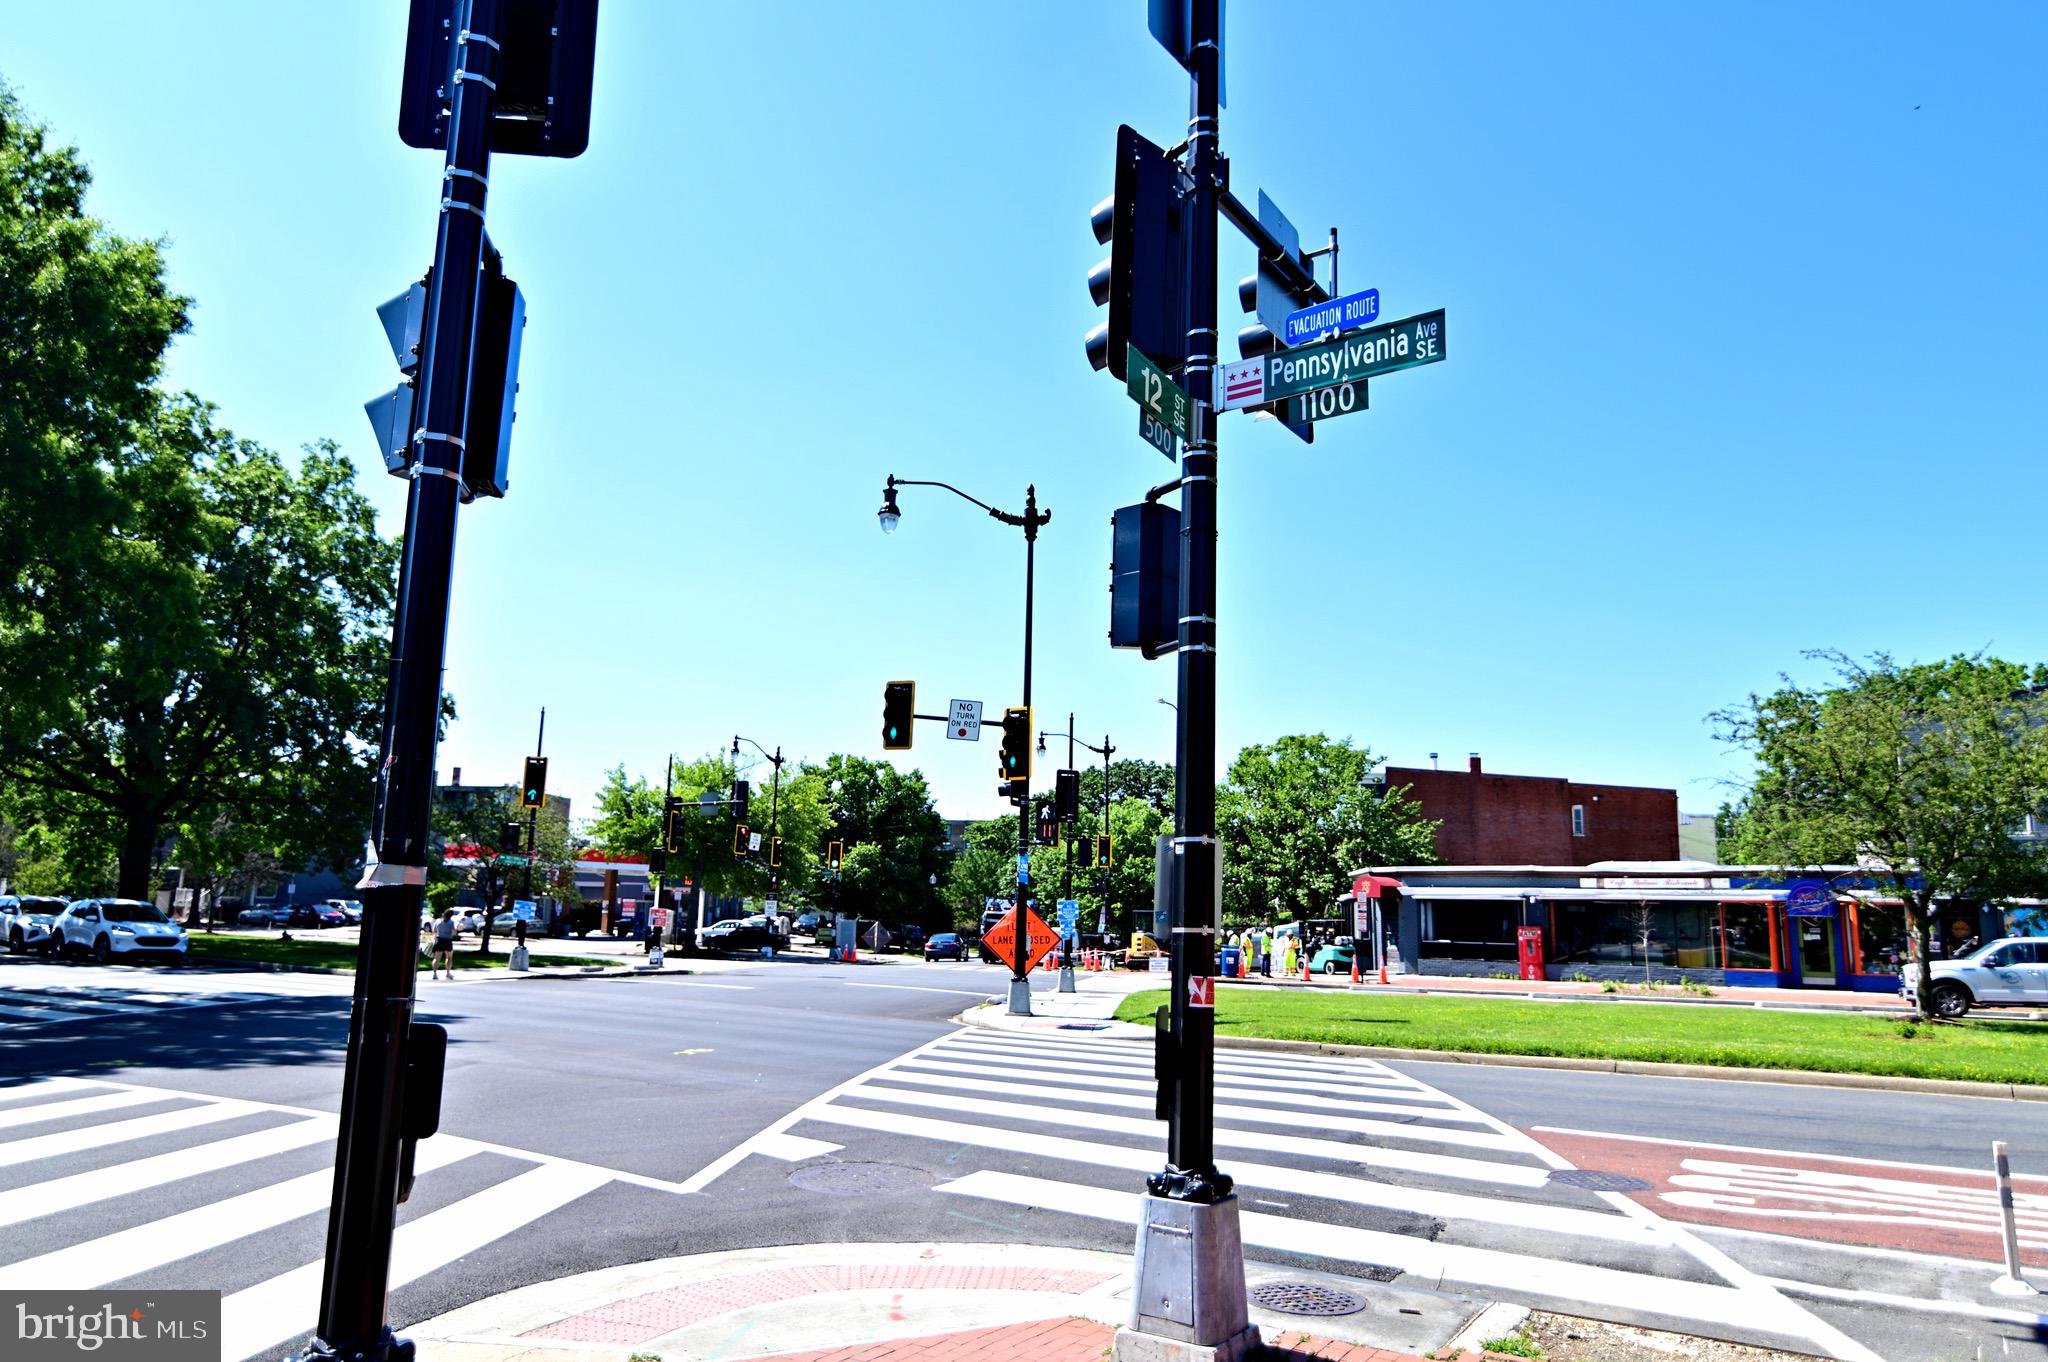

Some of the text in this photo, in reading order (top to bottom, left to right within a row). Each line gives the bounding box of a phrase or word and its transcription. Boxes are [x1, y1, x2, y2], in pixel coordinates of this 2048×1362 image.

[1289, 296, 1376, 337] EVACUATION ROUTE
[1271, 322, 1437, 386] Pennsylvania Ave
[1416, 338, 1437, 359] SE
[1141, 367, 1185, 413] 12 ST
[1300, 383, 1355, 420] 1100
[1146, 413, 1171, 453] 500
[1174, 410, 1185, 431] SE
[959, 703, 973, 711] NO
[964, 720, 977, 728] RED
[993, 936, 1013, 944] LANE
